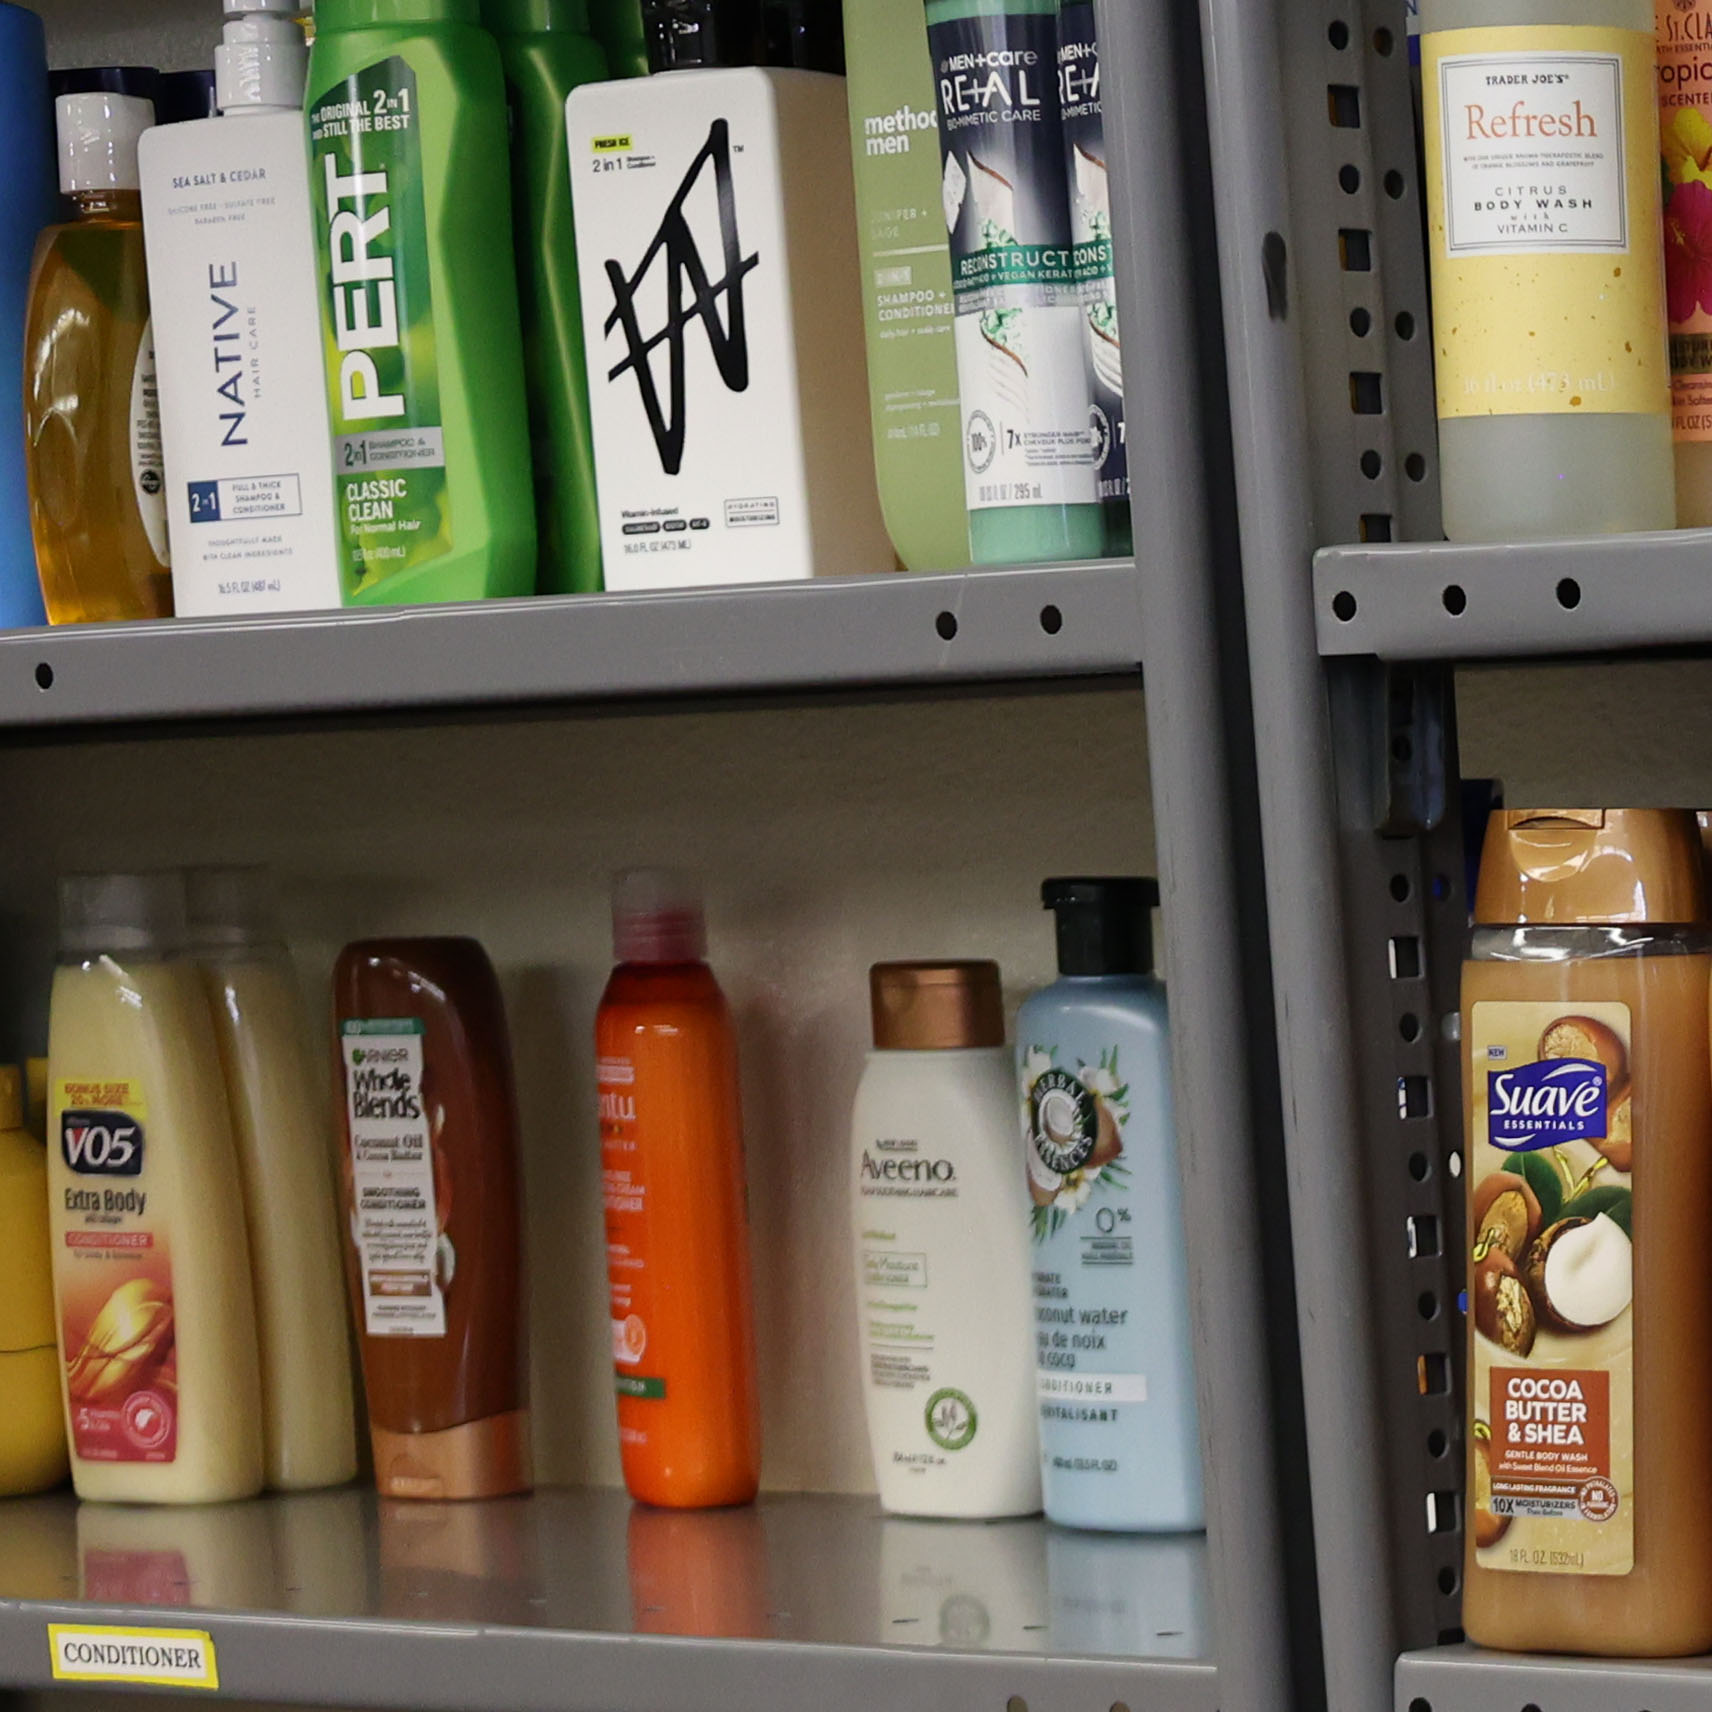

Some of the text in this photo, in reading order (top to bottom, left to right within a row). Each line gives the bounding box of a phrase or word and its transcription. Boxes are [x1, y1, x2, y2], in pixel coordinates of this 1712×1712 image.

[1486, 75, 1528, 86] TRADER
[324, 115, 410, 137] STILL BEST
[1464, 100, 1597, 140] Refresh
[866, 135, 909, 156] men
[173, 169, 266, 188] SEA SALT CEDAR
[960, 250, 1069, 275] RECONSTRUCT
[325, 152, 405, 420] PERT
[209, 261, 247, 446] NATIVE
[354, 1068, 411, 1091] Whole
[354, 1091, 420, 1119] Blends
[1490, 1074, 1600, 1117] Suave
[1504, 1120, 1584, 1130] ESSENTIALS
[65, 1126, 135, 1166] VO5
[65, 1188, 100, 1210] Extra
[1080, 1306, 1128, 1326] water
[1507, 1378, 1583, 1399] COCOA
[1505, 1400, 1587, 1422] BUTTER
[1525, 1423, 1584, 1445] SHEA
[64, 1643, 201, 1668] CONDITIONER
